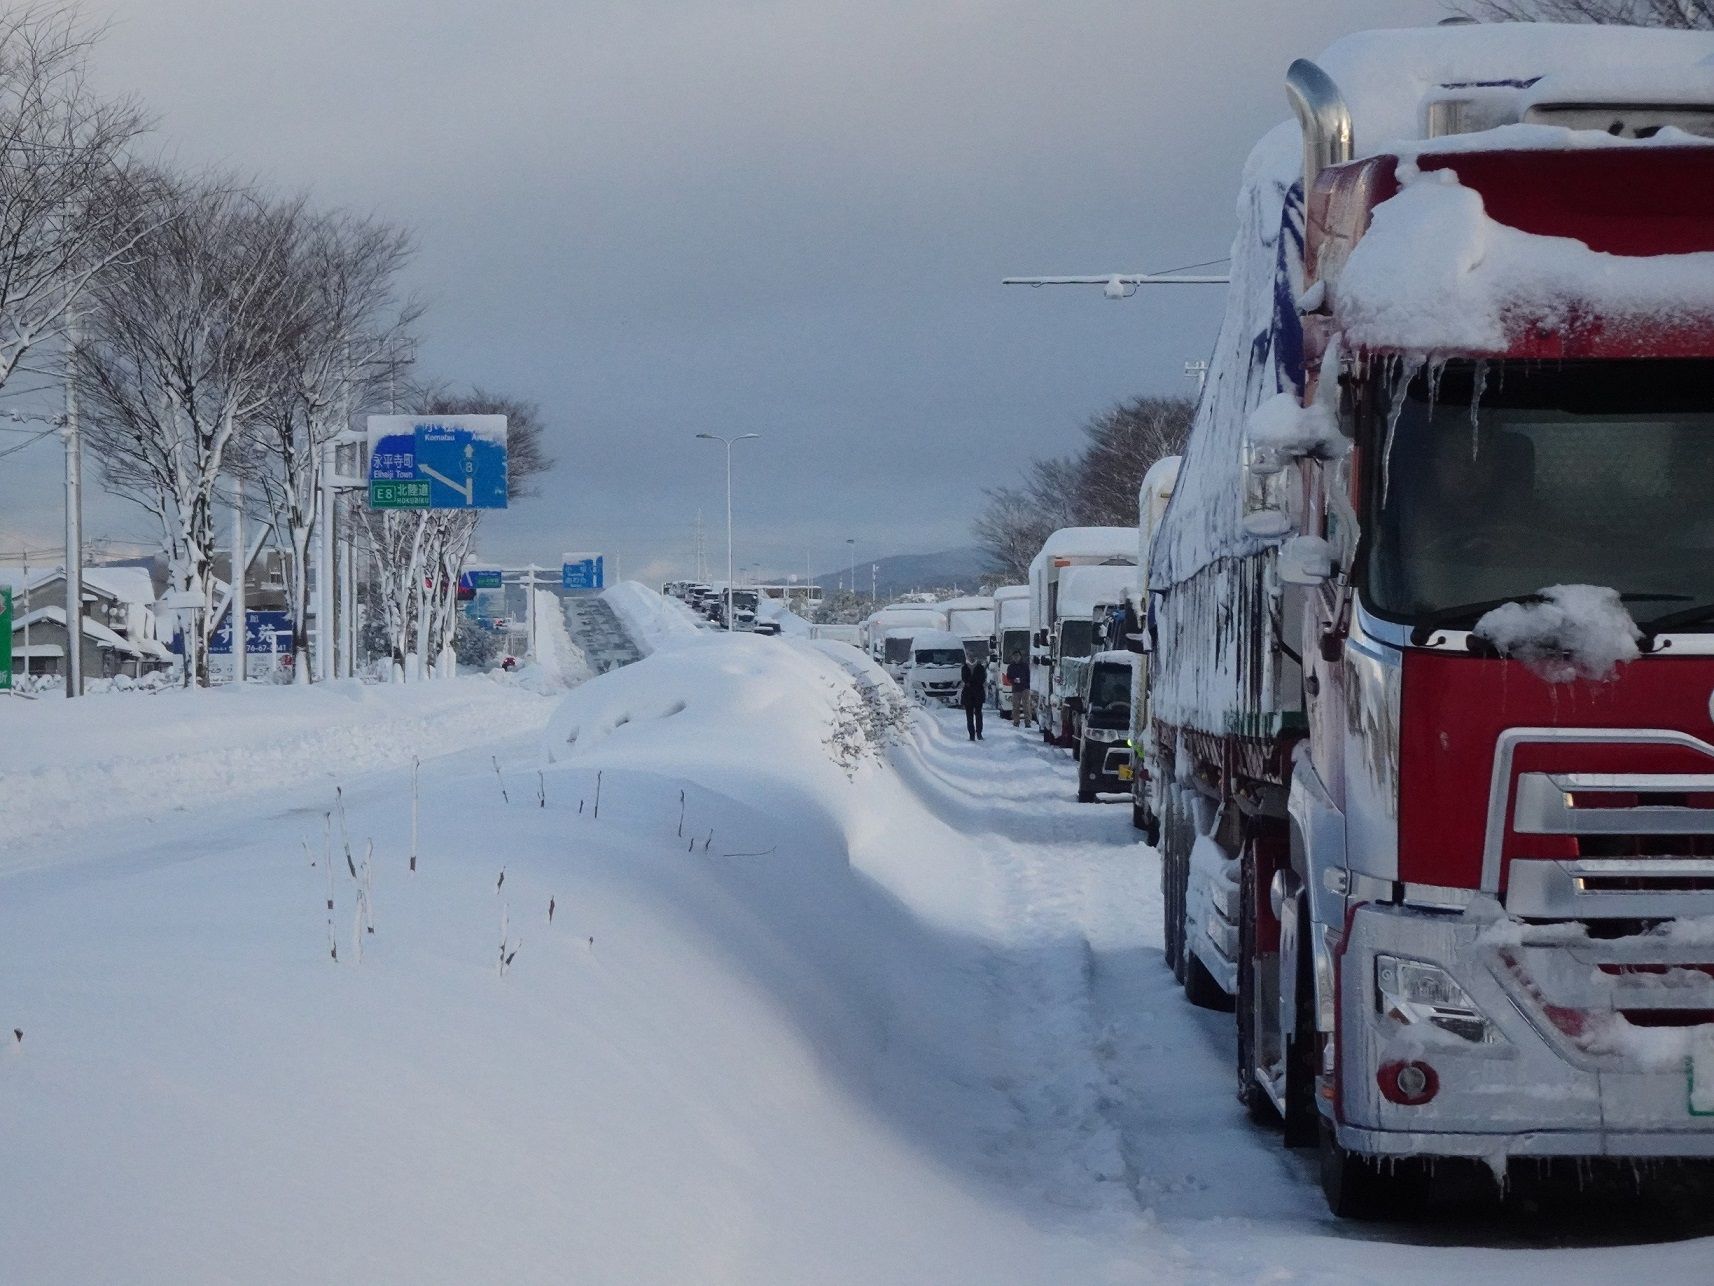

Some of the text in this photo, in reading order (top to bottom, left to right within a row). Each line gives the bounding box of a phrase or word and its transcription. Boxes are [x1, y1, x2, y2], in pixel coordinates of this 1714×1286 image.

[373, 453, 414, 468] 永平寺町
[465, 461, 473, 473] 8
[396, 470, 413, 478] Town
[397, 484, 429, 496] 北陸道
